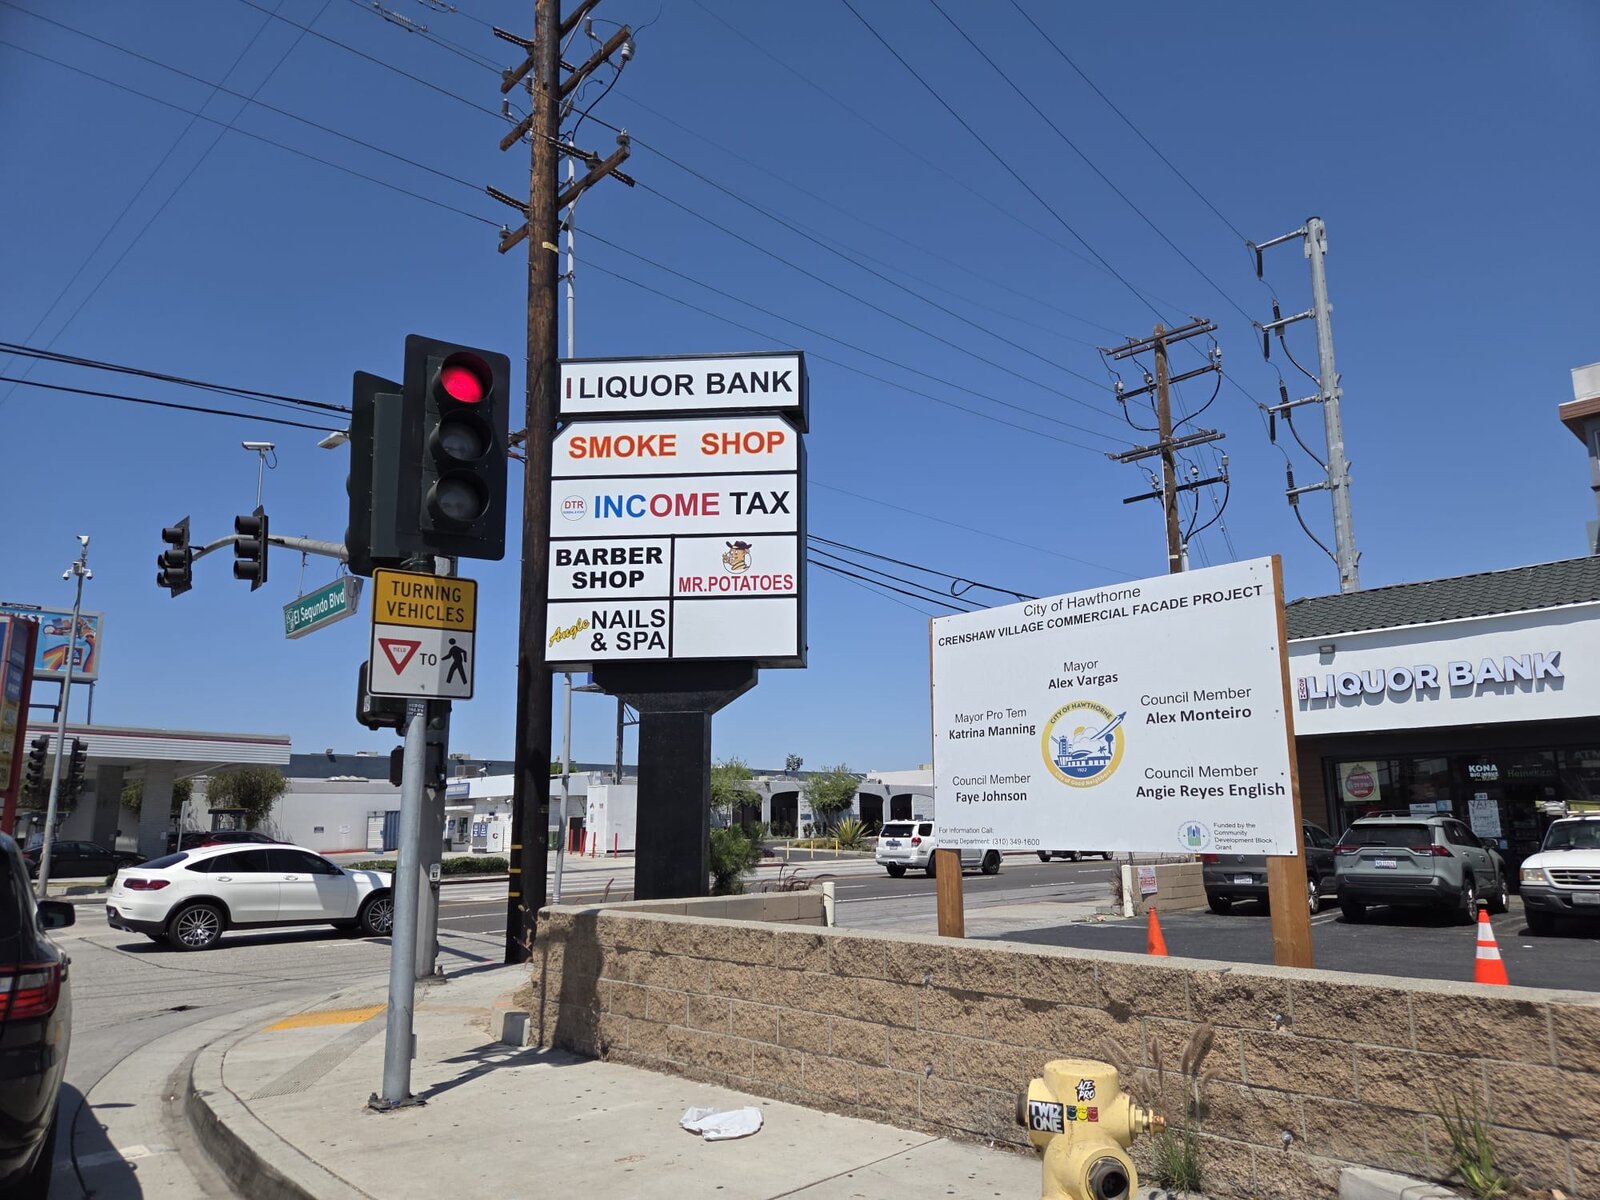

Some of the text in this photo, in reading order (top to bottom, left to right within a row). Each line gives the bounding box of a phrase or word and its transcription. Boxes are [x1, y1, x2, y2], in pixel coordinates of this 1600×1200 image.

[579, 374, 695, 400] LIQUOR
[706, 370, 793, 395] BANK
[568, 431, 785, 459] SMOKE SHOP
[564, 500, 584, 509] DTR
[593, 491, 790, 518] INCOME TAX
[555, 546, 663, 567] BARBER
[571, 570, 645, 589] SHOP
[678, 574, 794, 593] MR.POTATOES
[391, 580, 462, 602] TURNING
[293, 609, 300, 625] El
[300, 598, 329, 623] Segundo
[329, 588, 345, 609] Blvd
[1024, 586, 1141, 618] City of Hawthorne
[387, 601, 465, 623] VEHICLES
[591, 608, 666, 630] NAILS
[938, 584, 1264, 647] CRENSHAW VILLAGE COMMERCIAL FACADE PROJECT
[590, 631, 666, 652] & SPA
[420, 653, 438, 667] TO
[1063, 659, 1099, 674] Mayor
[1048, 671, 1119, 690] Alex Vargas
[1298, 651, 1565, 699] SOUTH LIQUOR BANK
[1140, 686, 1252, 707] Council Member
[955, 707, 1027, 725] Mayor Pro Tem
[1050, 702, 1113, 724] CITY OF HAWTHORNE
[1146, 706, 1252, 725] Alex Monteiro
[949, 723, 1036, 740] Katrina Manning
[1144, 764, 1259, 779] Council Member
[1468, 764, 1498, 773] KONA
[952, 773, 1031, 787] Council Member
[956, 789, 1028, 804] Faye Johnson
[1136, 781, 1286, 799] Angie Reyes English
[1237, 822, 1245, 830] by
[992, 838, 1009, 846] (310)
[1009, 838, 1040, 846] 349-1600
[1078, 1090, 1096, 1101] PRO
[1033, 1115, 1064, 1134] ONE
